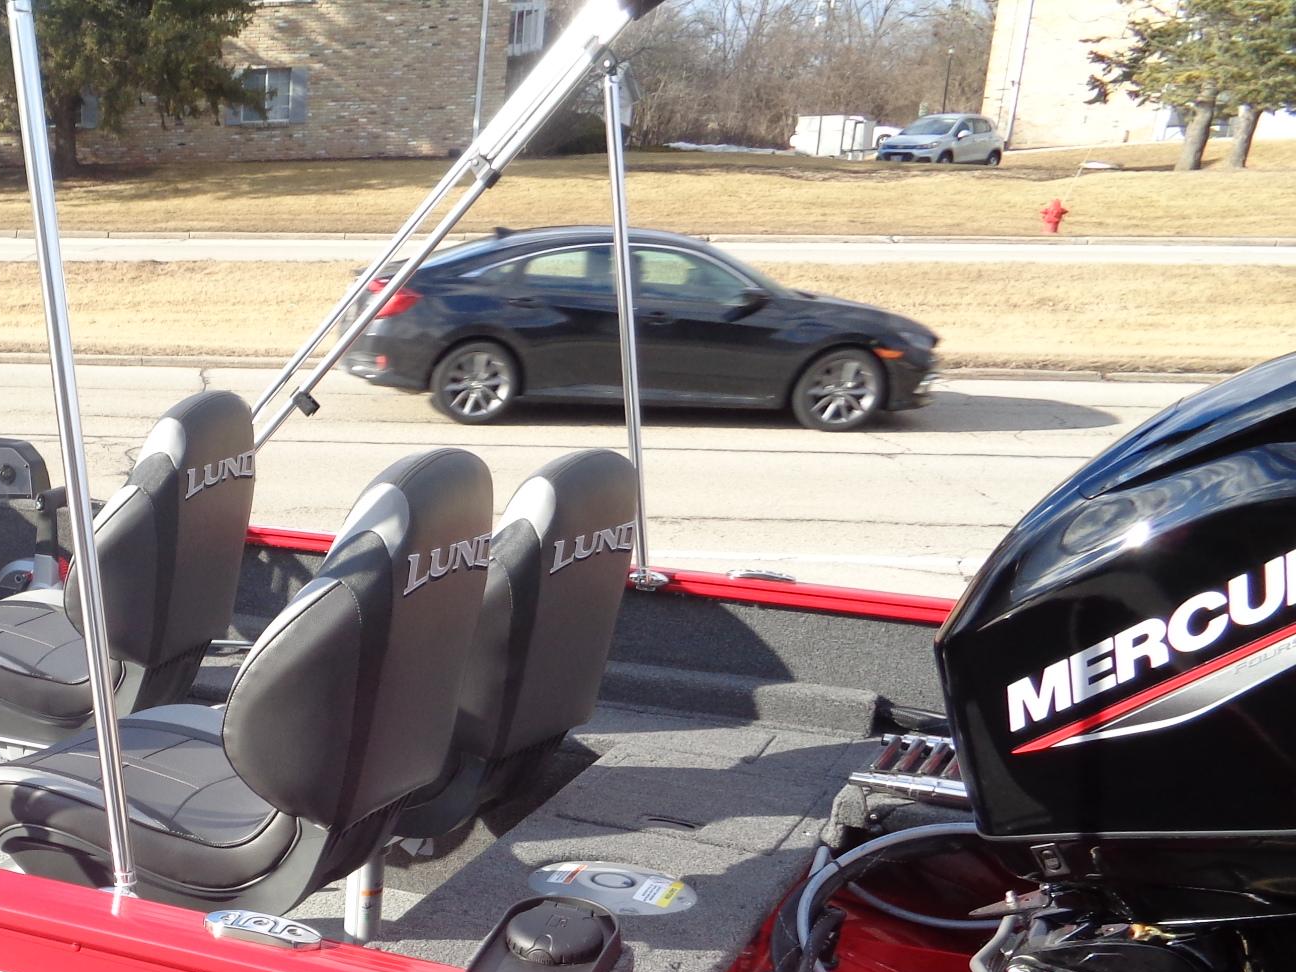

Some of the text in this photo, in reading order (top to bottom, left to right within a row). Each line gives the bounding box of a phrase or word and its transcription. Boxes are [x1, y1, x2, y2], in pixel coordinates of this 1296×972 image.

[185, 448, 256, 499] LUND
[549, 519, 638, 574] LUND
[1007, 548, 1296, 733] MERCU
